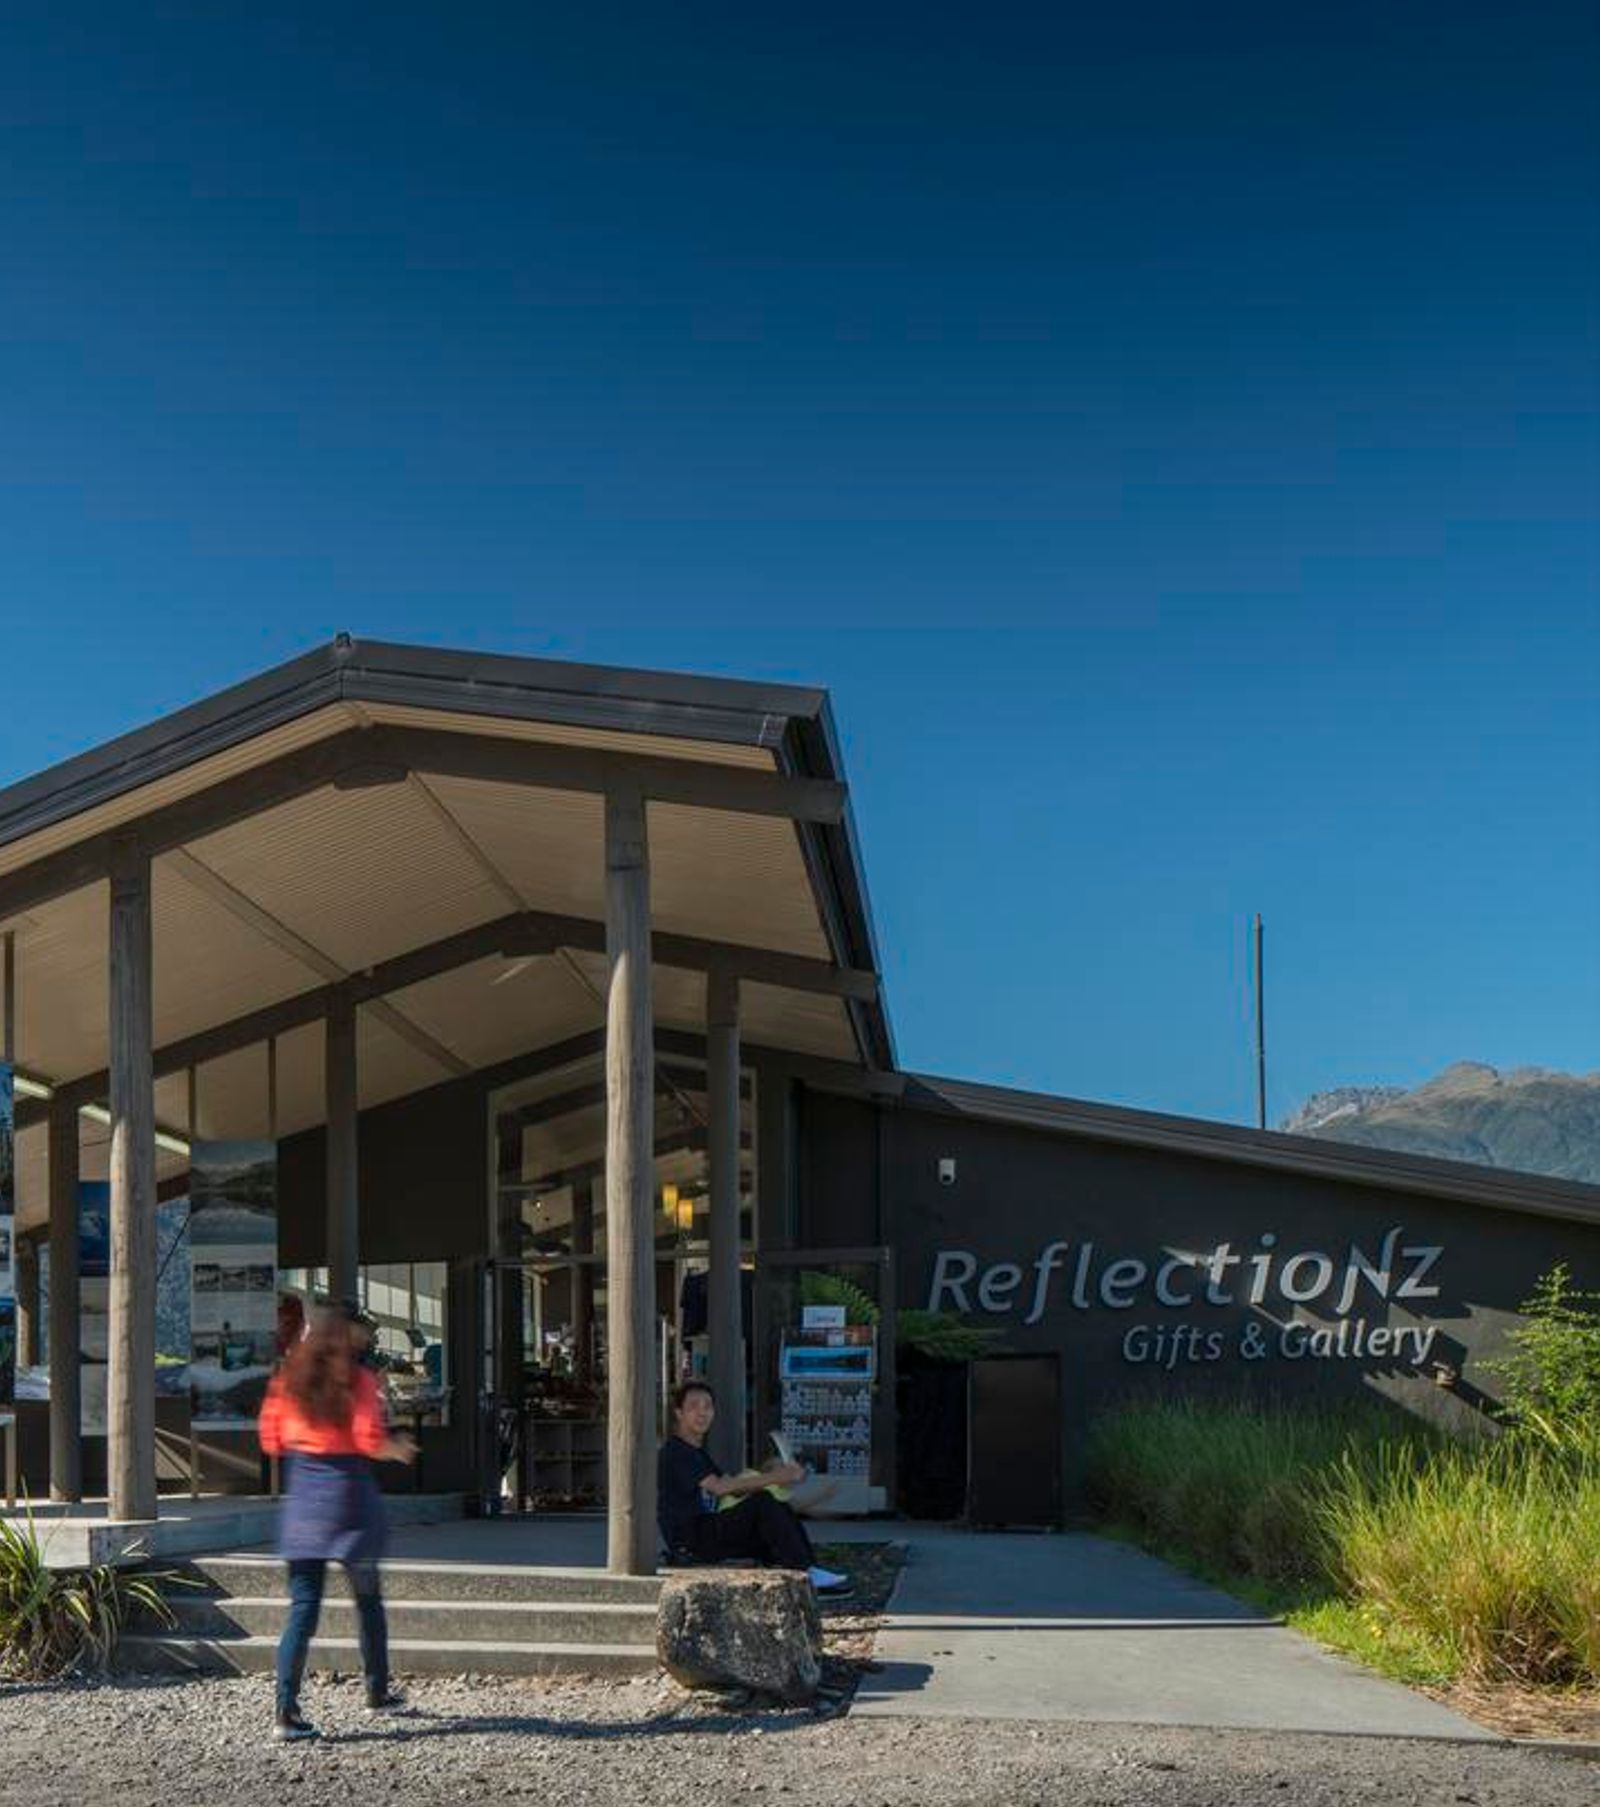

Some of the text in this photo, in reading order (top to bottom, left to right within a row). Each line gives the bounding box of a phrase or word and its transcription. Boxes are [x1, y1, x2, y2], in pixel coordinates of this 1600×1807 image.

[1122, 1317, 1437, 1369] Gifts & Gallery
